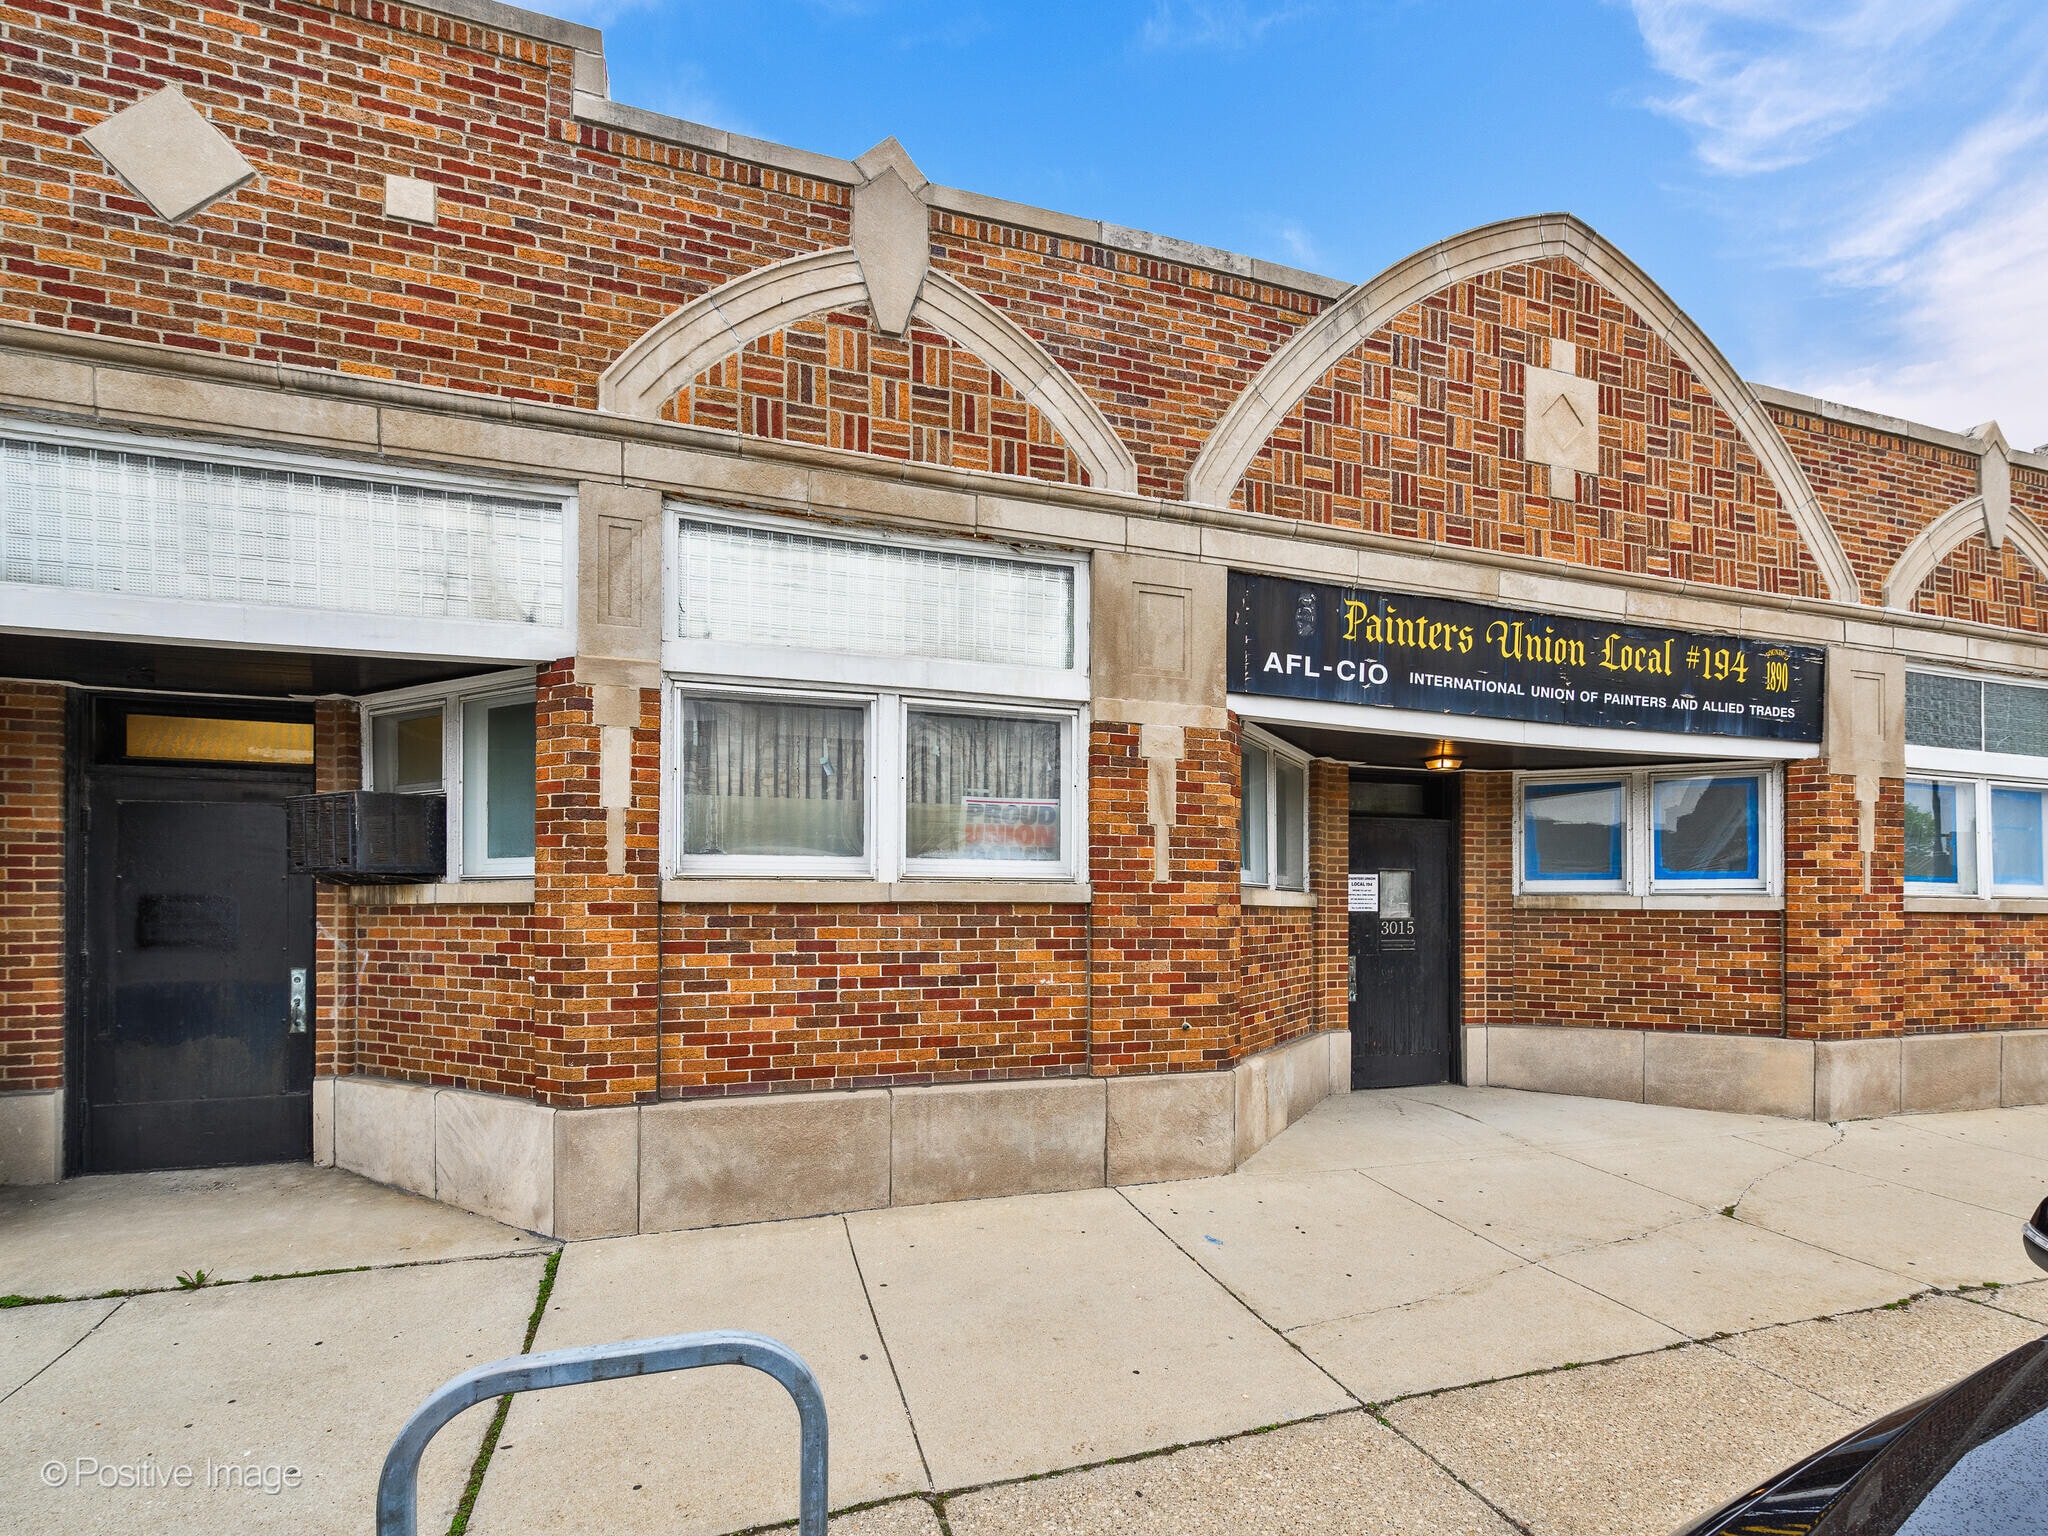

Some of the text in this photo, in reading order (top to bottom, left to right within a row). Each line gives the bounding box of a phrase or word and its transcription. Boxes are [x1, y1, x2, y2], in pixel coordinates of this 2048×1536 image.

[1342, 598, 1749, 684] Painters Union Local #194
[1263, 651, 1388, 685] AFL-CIO
[1766, 661, 1788, 693] 1890
[1409, 672, 1796, 719] INTERNATIONAL UNION OF PAINTERS AND ALLIED TRADES
[966, 803, 1057, 825] PROUD
[965, 824, 1057, 847] UNION
[1380, 920, 1415, 935] 3015
